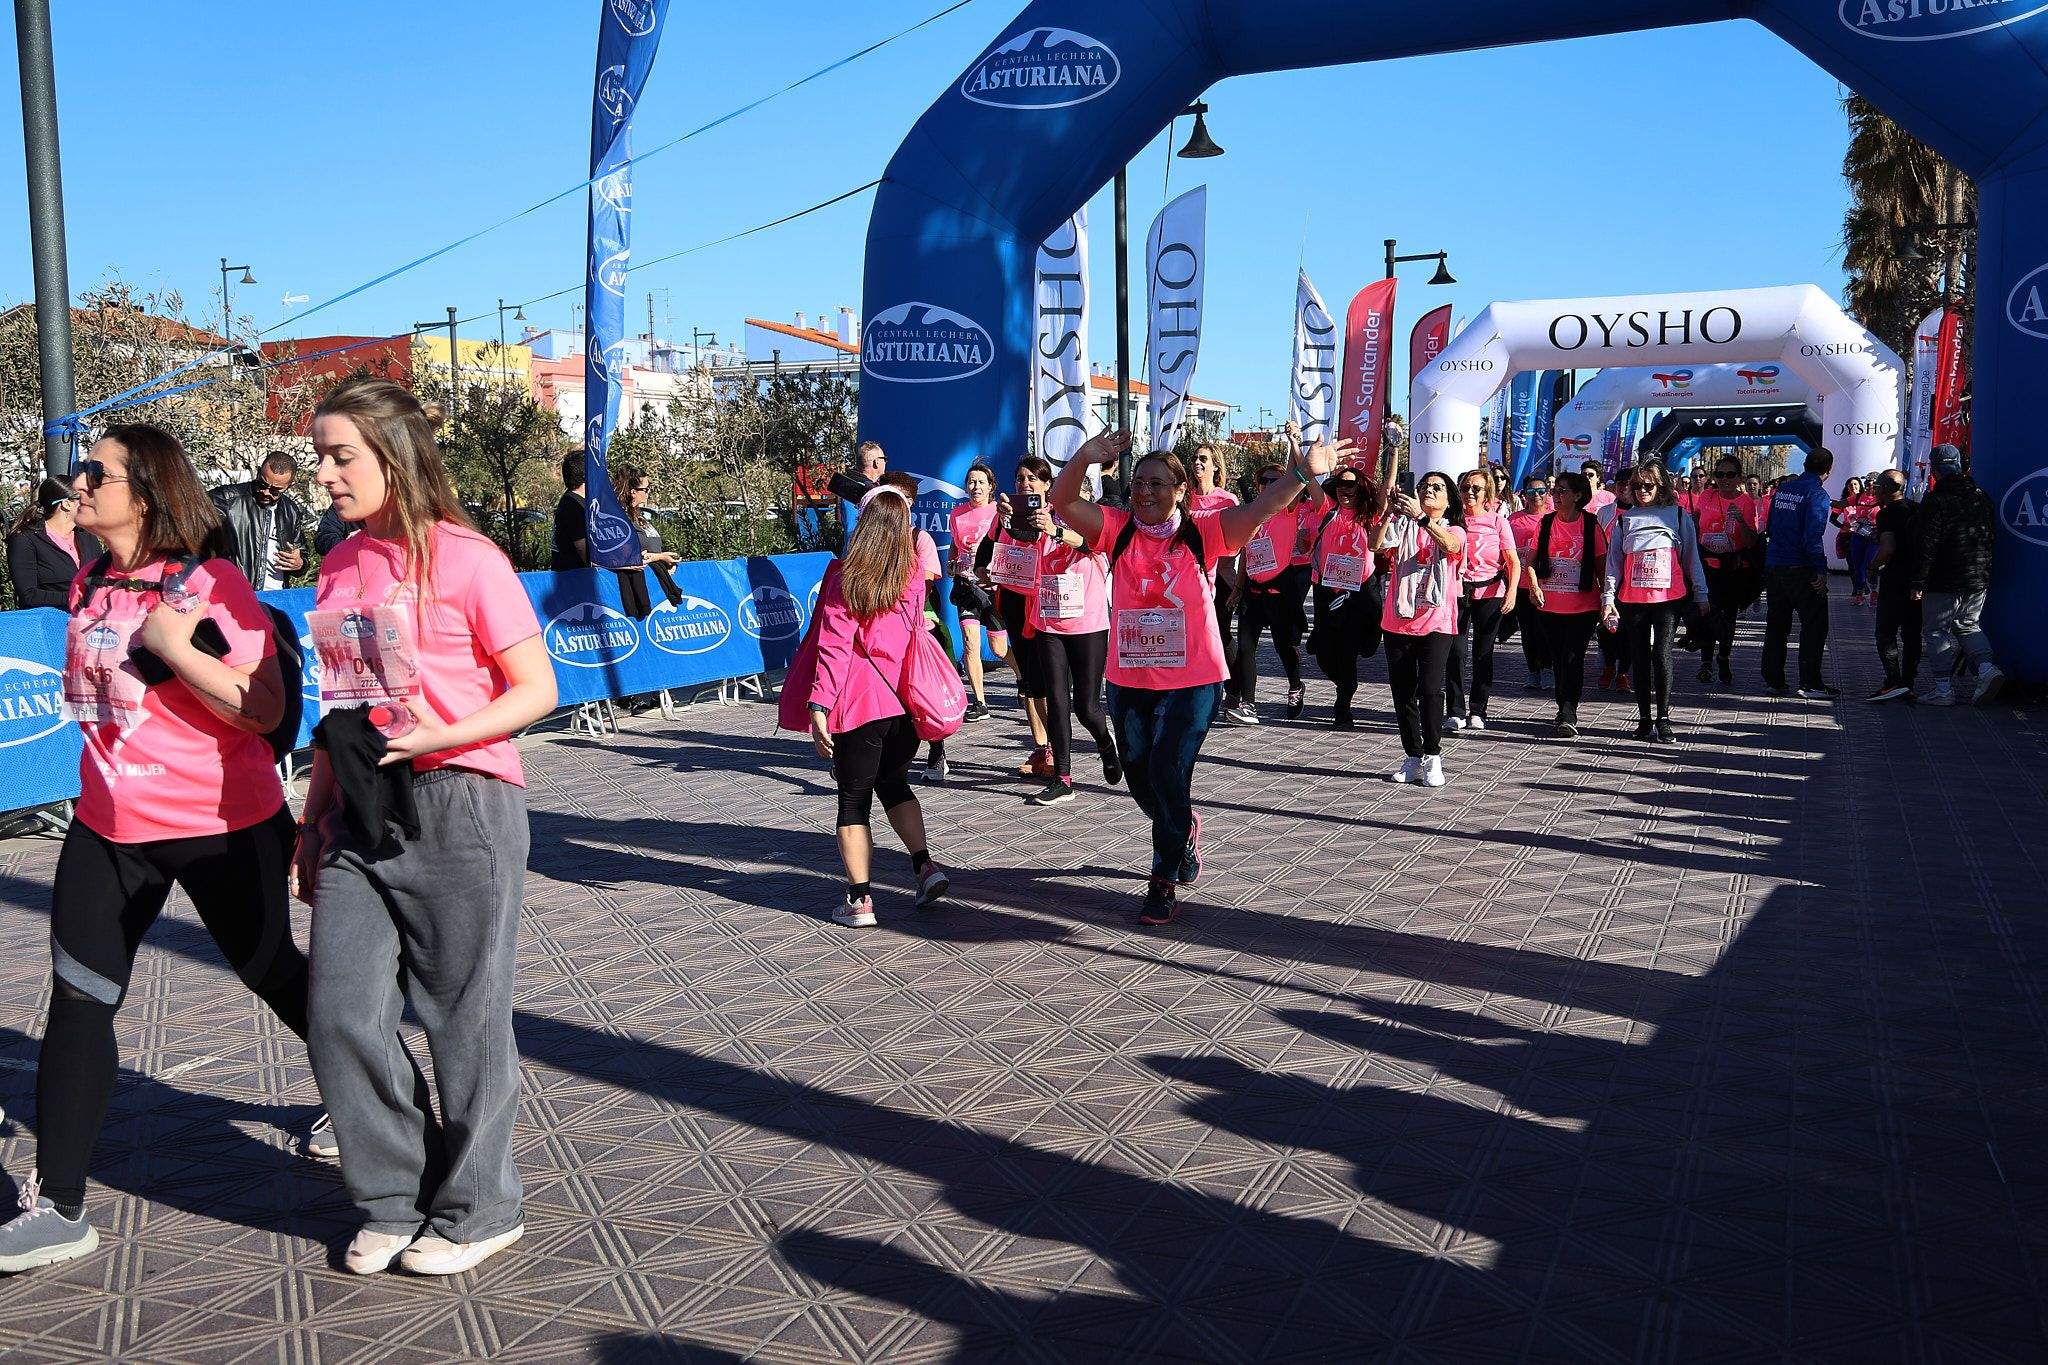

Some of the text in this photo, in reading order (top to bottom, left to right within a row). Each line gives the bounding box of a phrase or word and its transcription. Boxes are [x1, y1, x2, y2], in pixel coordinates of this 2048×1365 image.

[994, 52, 1102, 67] CENTRAL LECHERA
[969, 64, 1108, 93] ASTURIANA
[877, 329, 980, 341] CENTRAL LECHERA
[1549, 306, 1742, 350] OYSHO
[864, 333, 983, 365] ASTURIANA
[1800, 342, 1863, 357] OYSHO
[1357, 308, 1381, 405] Santander
[1440, 360, 1493, 371] OYSHO
[1736, 387, 1780, 395] TotalEnergies
[1512, 391, 1535, 448] Marlene
[1693, 416, 1787, 427] VOLVO
[1833, 422, 1891, 436] OYSHO
[1414, 432, 1464, 444] OYSHO
[1006, 562, 1023, 571] 016
[1053, 593, 1069, 601] 016
[662, 611, 720, 624] CENTRAL LECHERA
[745, 608, 802, 629] ASTURIANA
[654, 618, 728, 644] ASTURIANA
[554, 628, 635, 655] ASTURIANA
[1141, 635, 1165, 645] 016
[353, 657, 385, 675] 016
[0, 678, 57, 692] ECHERA
[333, 691, 355, 699] CARRERA
[126, 763, 167, 777] MUJER
